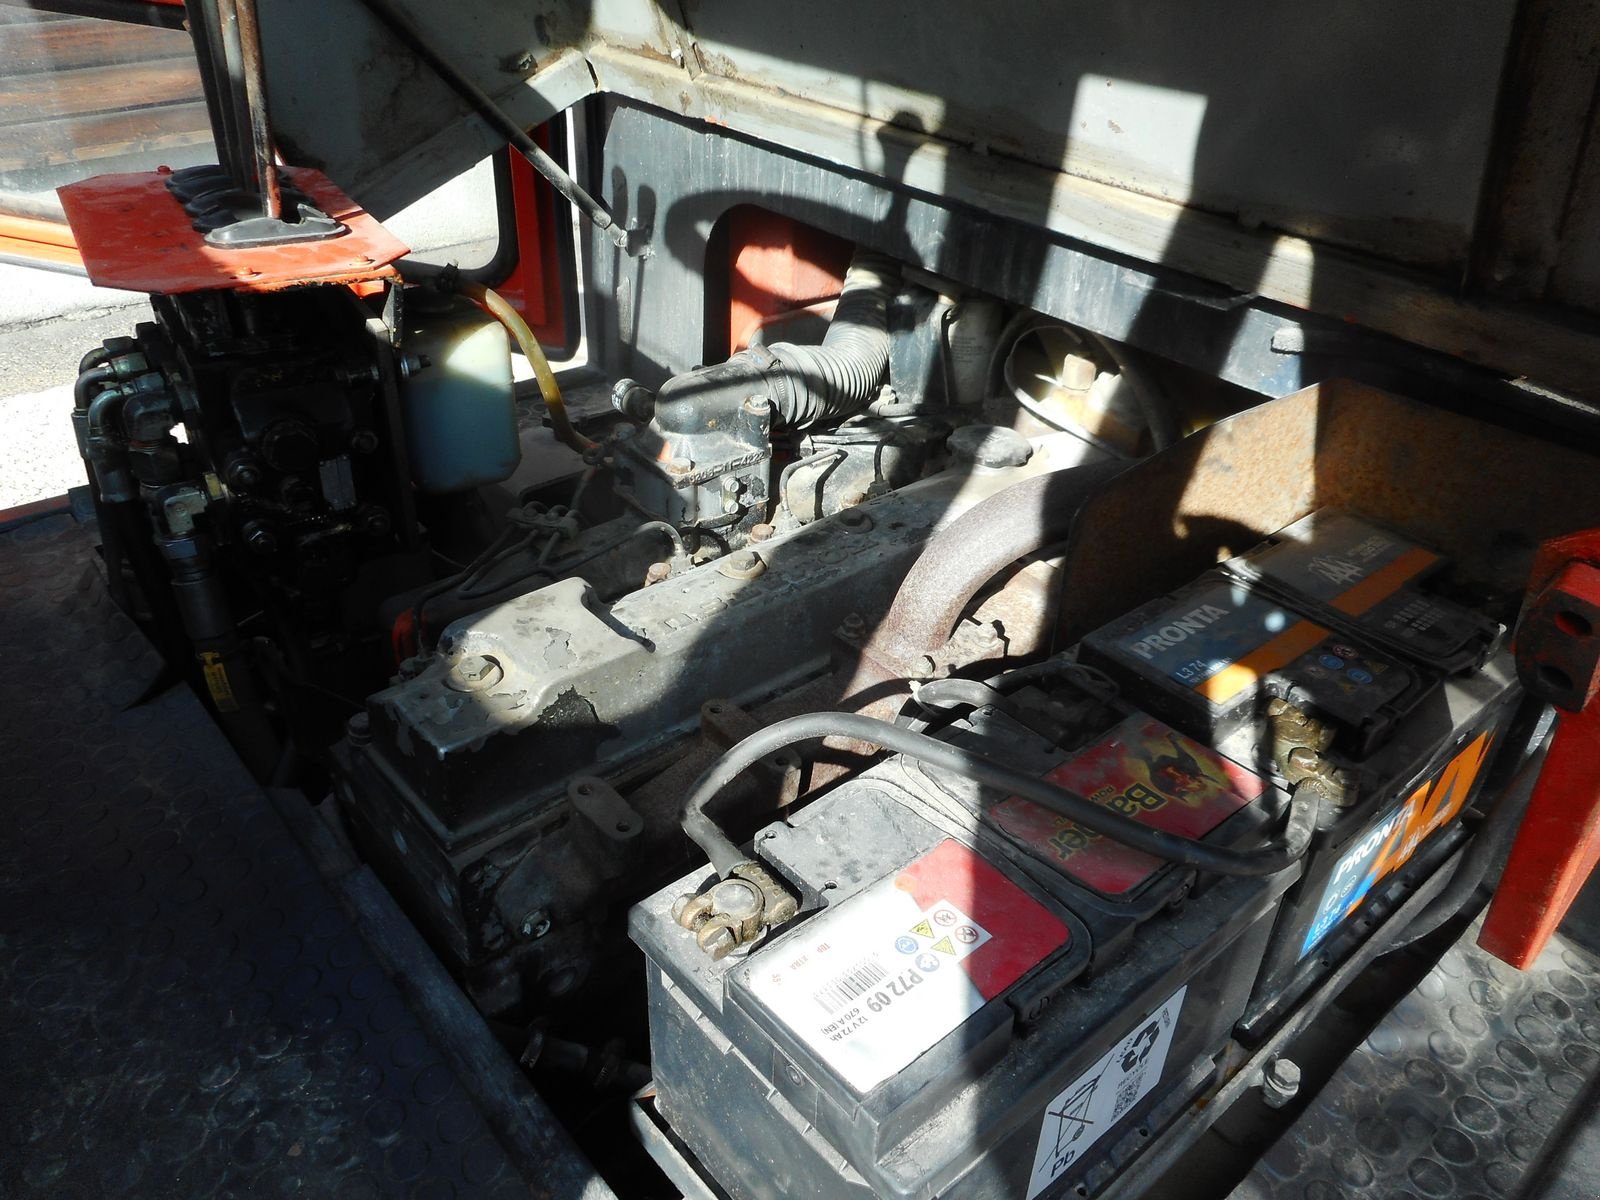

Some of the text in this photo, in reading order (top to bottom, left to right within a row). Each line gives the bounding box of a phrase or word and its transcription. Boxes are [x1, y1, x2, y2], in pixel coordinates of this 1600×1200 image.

[1130, 604, 1230, 660] PRONTA
[1175, 665, 1194, 679] L3
[1188, 659, 1208, 672] 74
[1333, 799, 1417, 884] PRONTA
[886, 968, 924, 996] P72
[866, 991, 892, 1012] 09
[837, 1017, 846, 1026] A
[844, 1007, 861, 1020] 670
[857, 1015, 869, 1025] 12
[841, 1025, 854, 1037] 72
[1051, 1150, 1076, 1178] Pb
